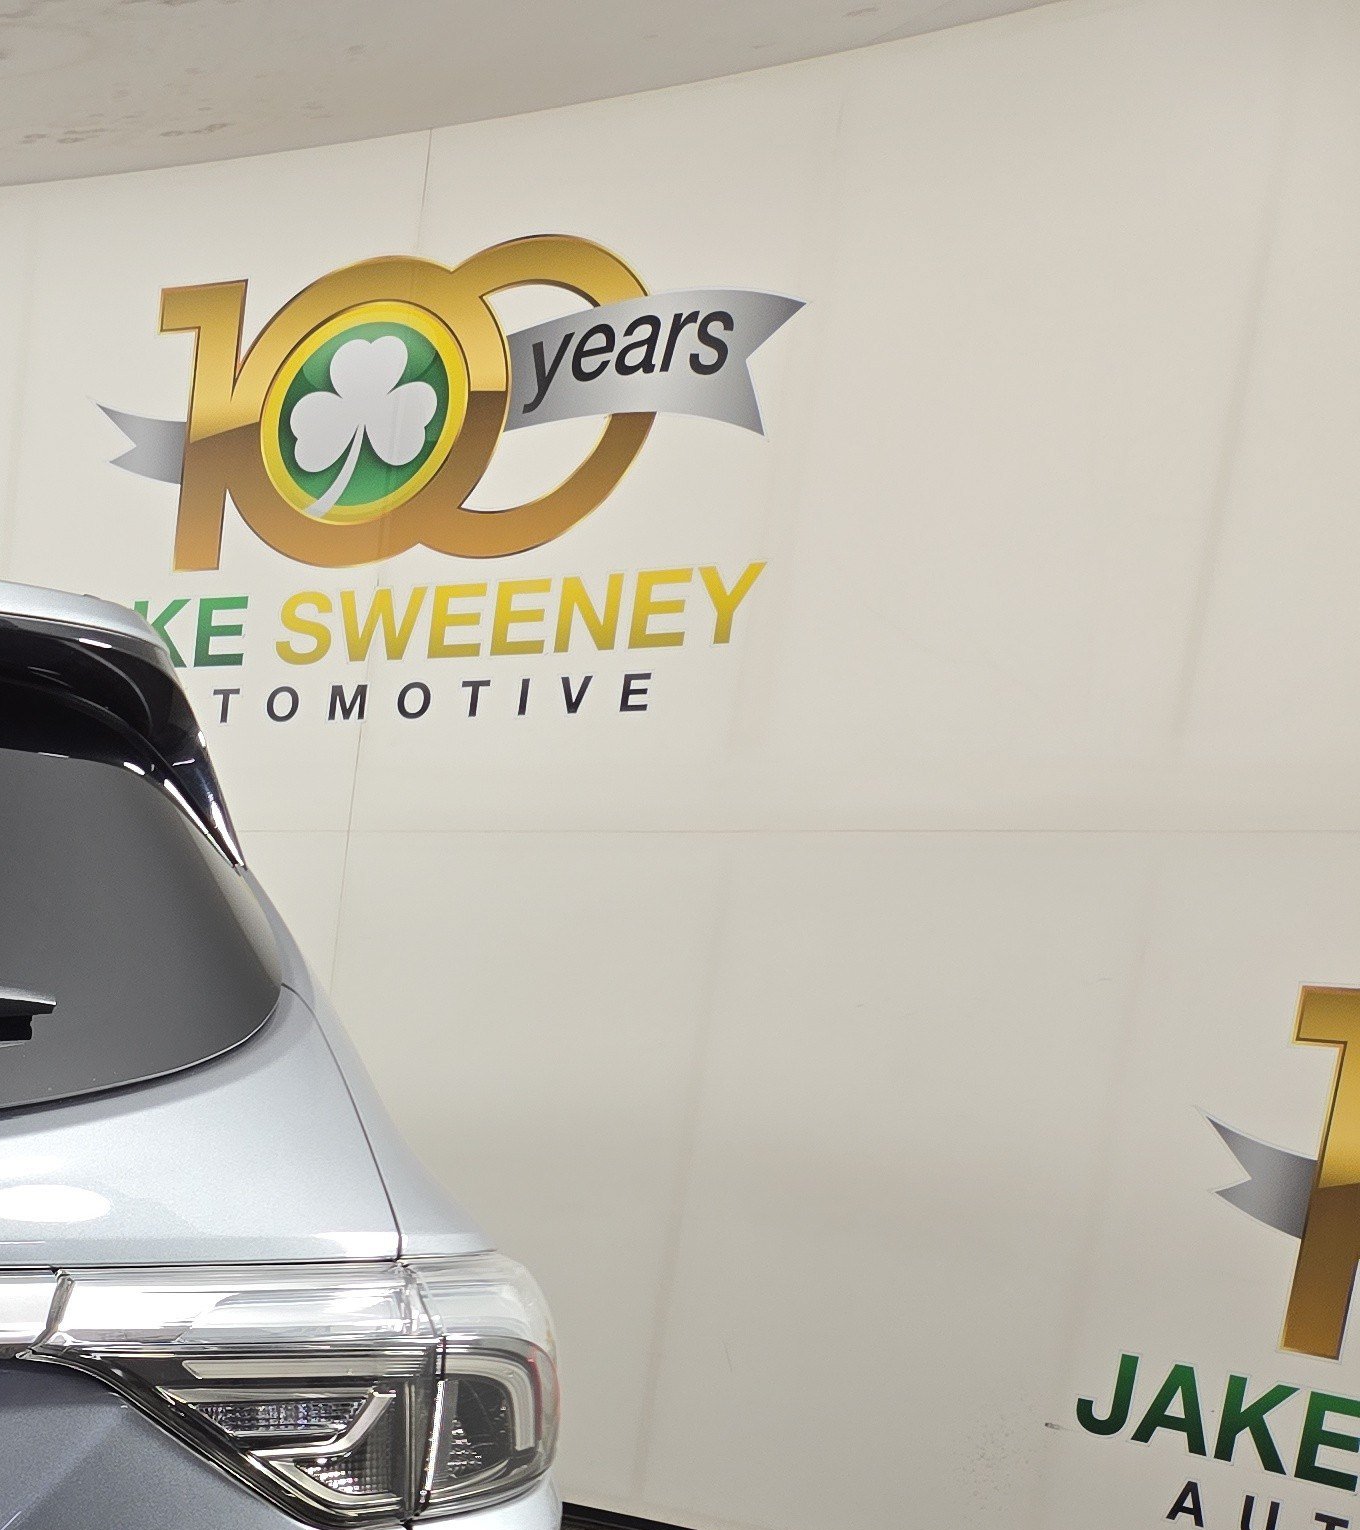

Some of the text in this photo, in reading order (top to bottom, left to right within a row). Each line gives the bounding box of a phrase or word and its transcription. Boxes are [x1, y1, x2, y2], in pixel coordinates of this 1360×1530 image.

[159, 234, 658, 572] 100
[523, 309, 735, 414] years
[275, 561, 767, 666] SWEENEY
[212, 672, 653, 724] TOMOTIVE
[1076, 1352, 1360, 1493] JAKE
